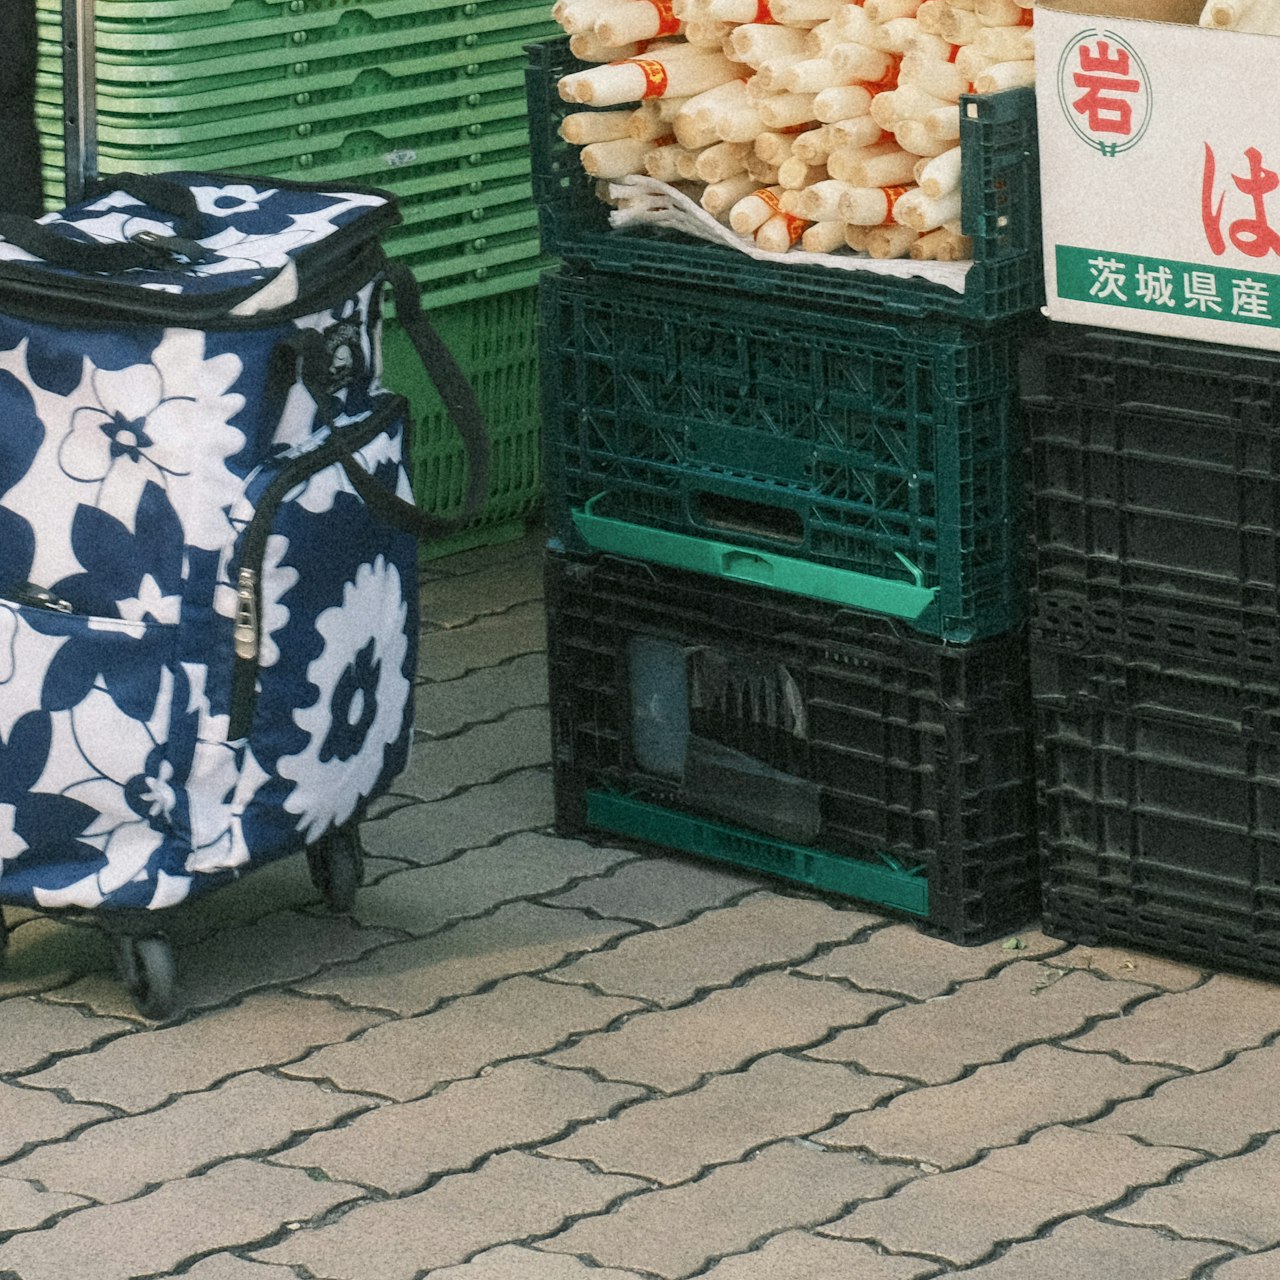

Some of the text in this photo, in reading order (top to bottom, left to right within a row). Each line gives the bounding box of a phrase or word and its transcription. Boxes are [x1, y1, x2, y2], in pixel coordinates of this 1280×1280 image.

[1071, 39, 1141, 136] 岩
[1088, 256, 1273, 320] 茨城県産
